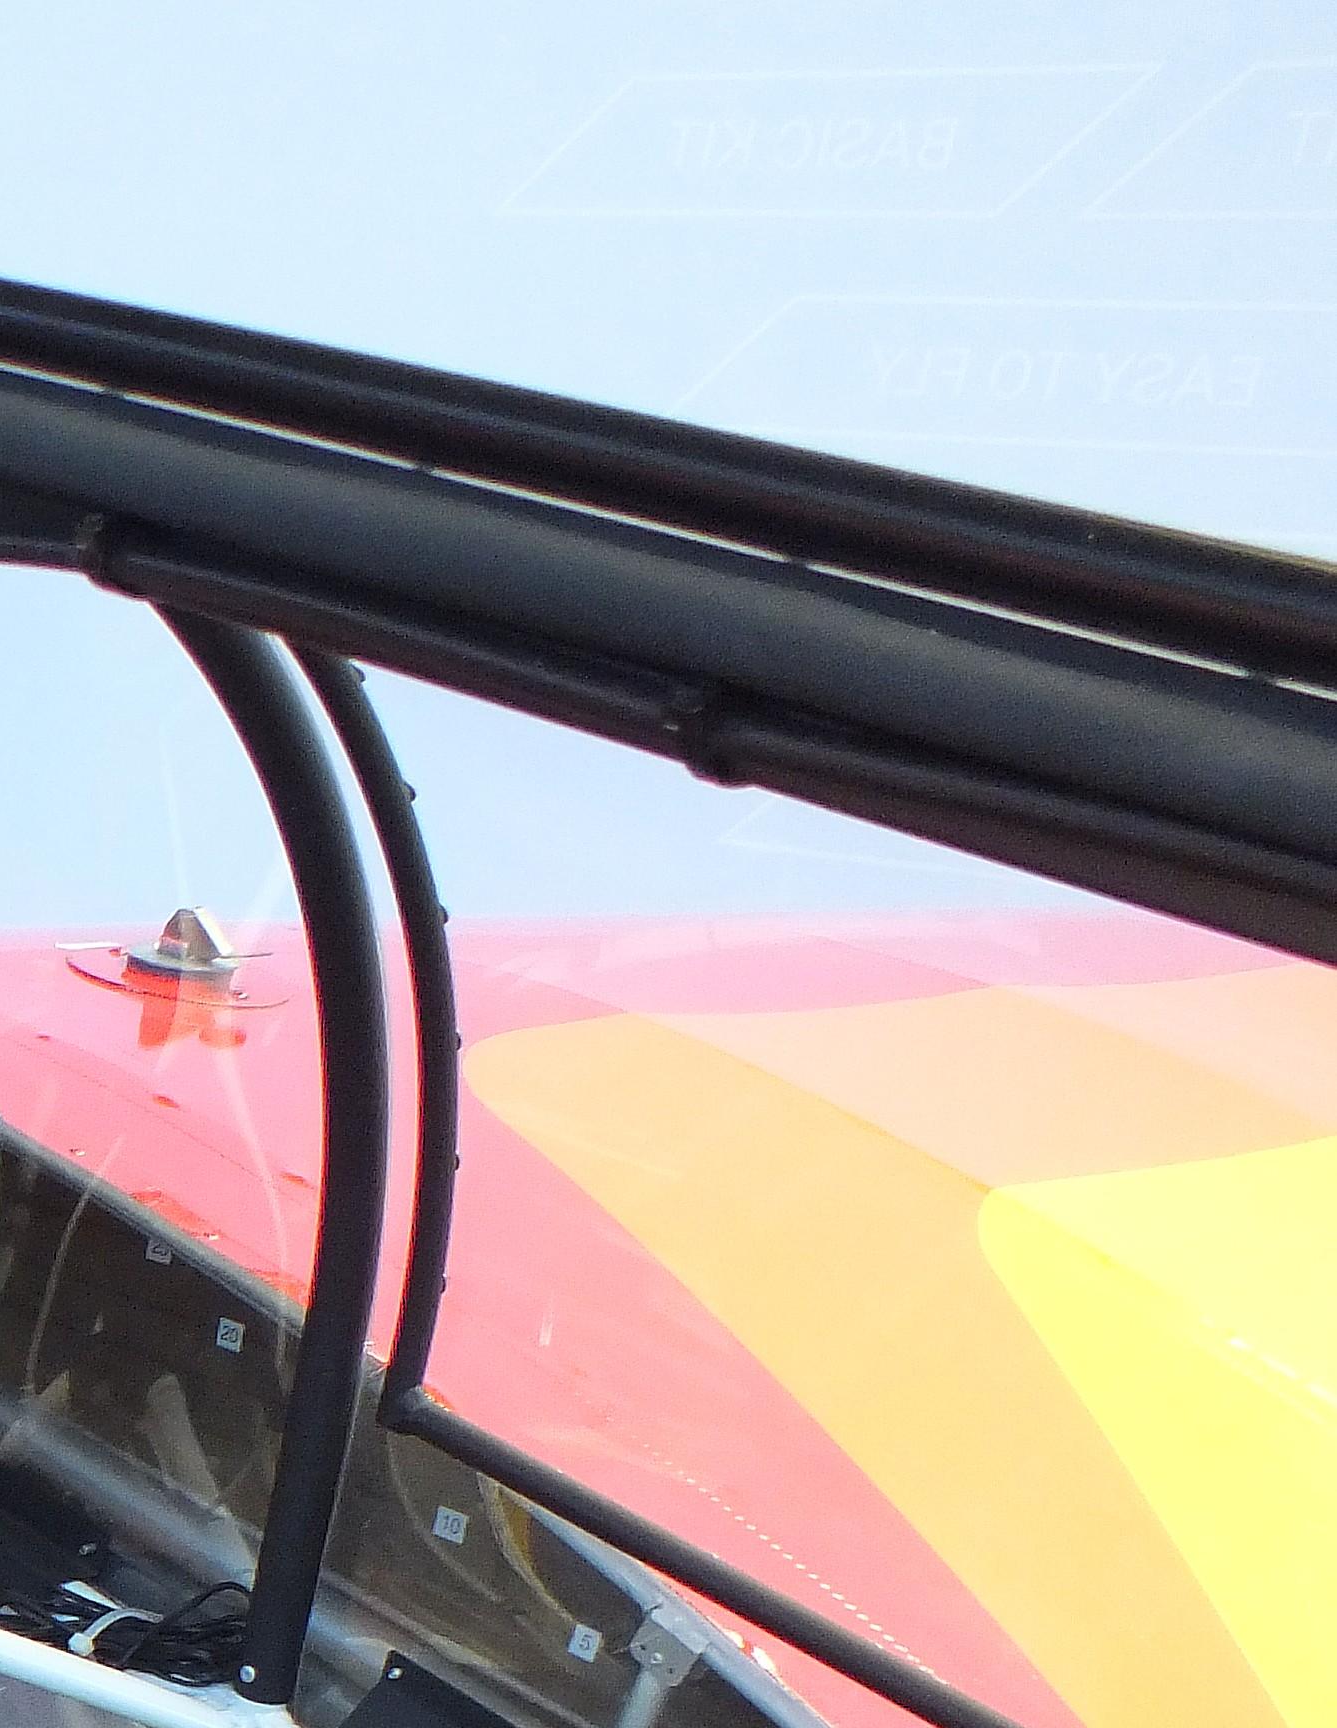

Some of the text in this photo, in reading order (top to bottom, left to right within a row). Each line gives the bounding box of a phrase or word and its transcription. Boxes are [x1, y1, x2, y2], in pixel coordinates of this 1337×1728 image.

[220, 1325, 239, 1343] 20
[443, 1514, 460, 1535] 10
[579, 1633, 592, 1650] 5
